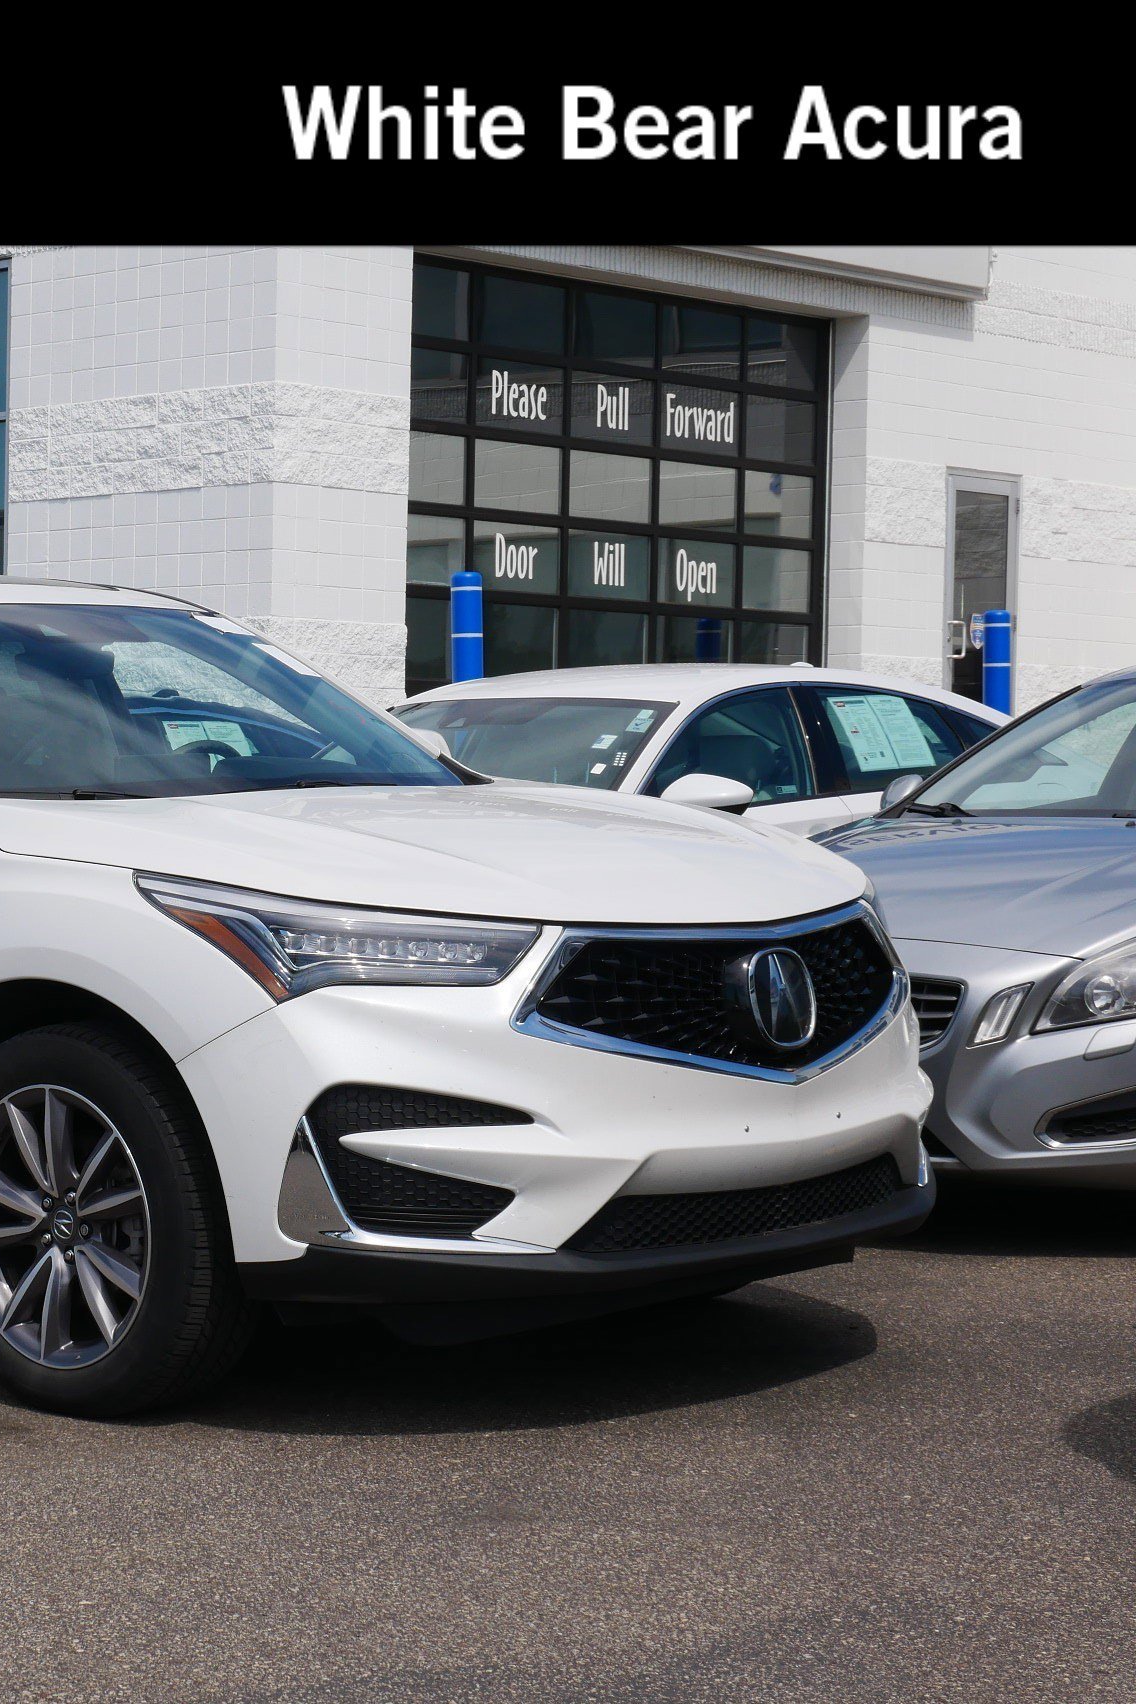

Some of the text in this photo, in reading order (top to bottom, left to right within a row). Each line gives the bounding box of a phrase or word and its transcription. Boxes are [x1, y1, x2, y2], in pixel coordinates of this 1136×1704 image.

[491, 369, 734, 444] Please Pull Forward
[495, 532, 717, 602] Door Will Open
